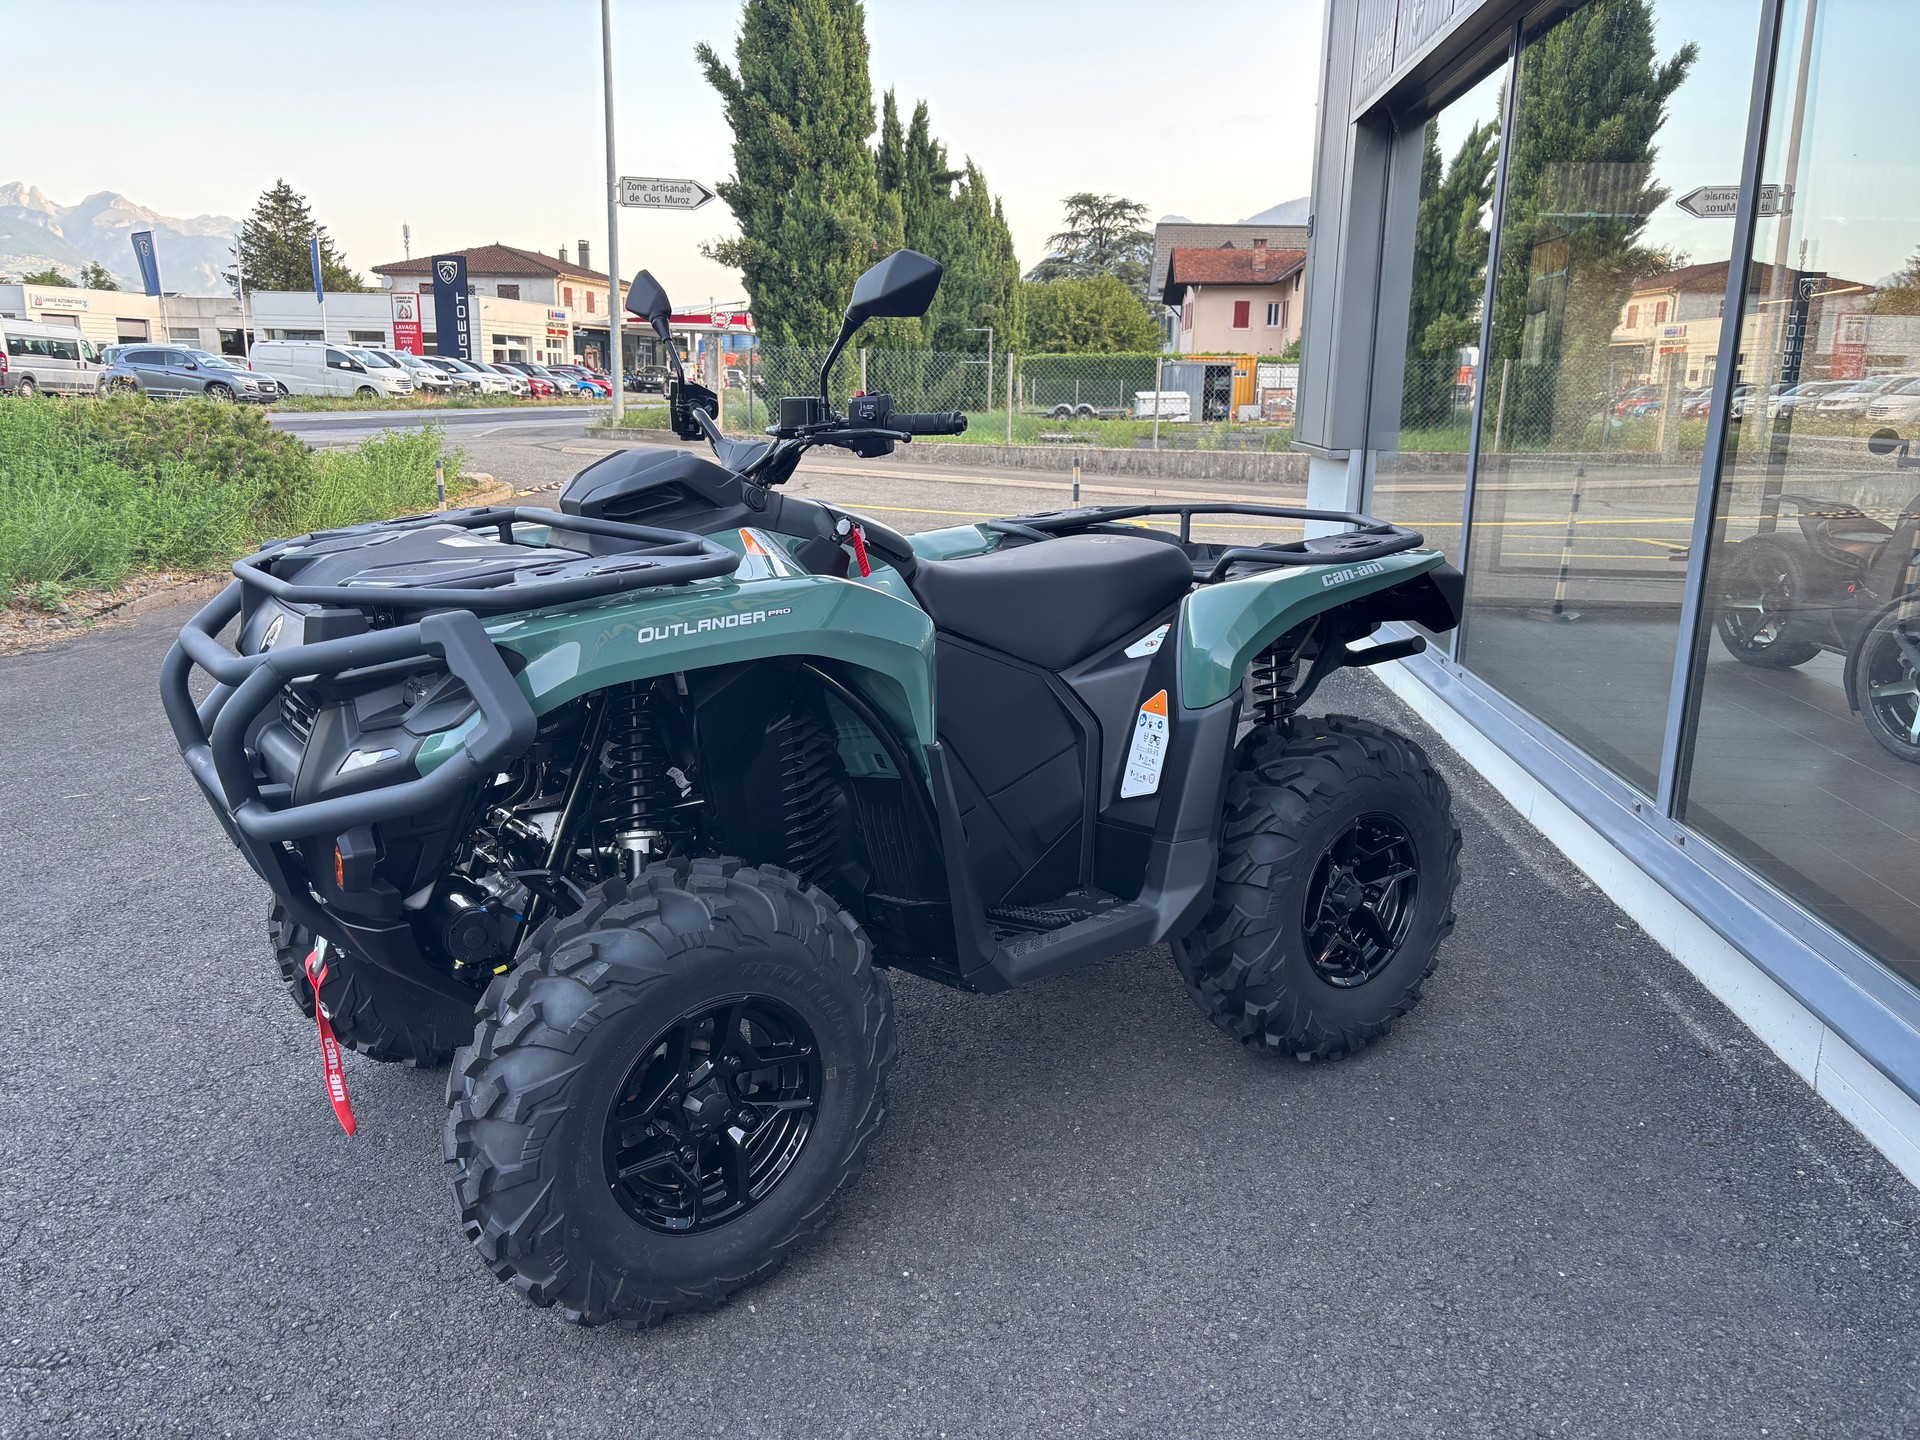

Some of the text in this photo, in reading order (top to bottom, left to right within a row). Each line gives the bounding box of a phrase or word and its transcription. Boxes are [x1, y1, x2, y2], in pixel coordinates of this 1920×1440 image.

[626, 182, 692, 193] Zone artisanale
[629, 193, 690, 204] de Clos Muroz
[455, 291, 469, 361] UGEOT
[1321, 562, 1384, 587] can-am
[637, 607, 791, 644] OUTLANDER PRO
[324, 1037, 346, 1102] can-am
